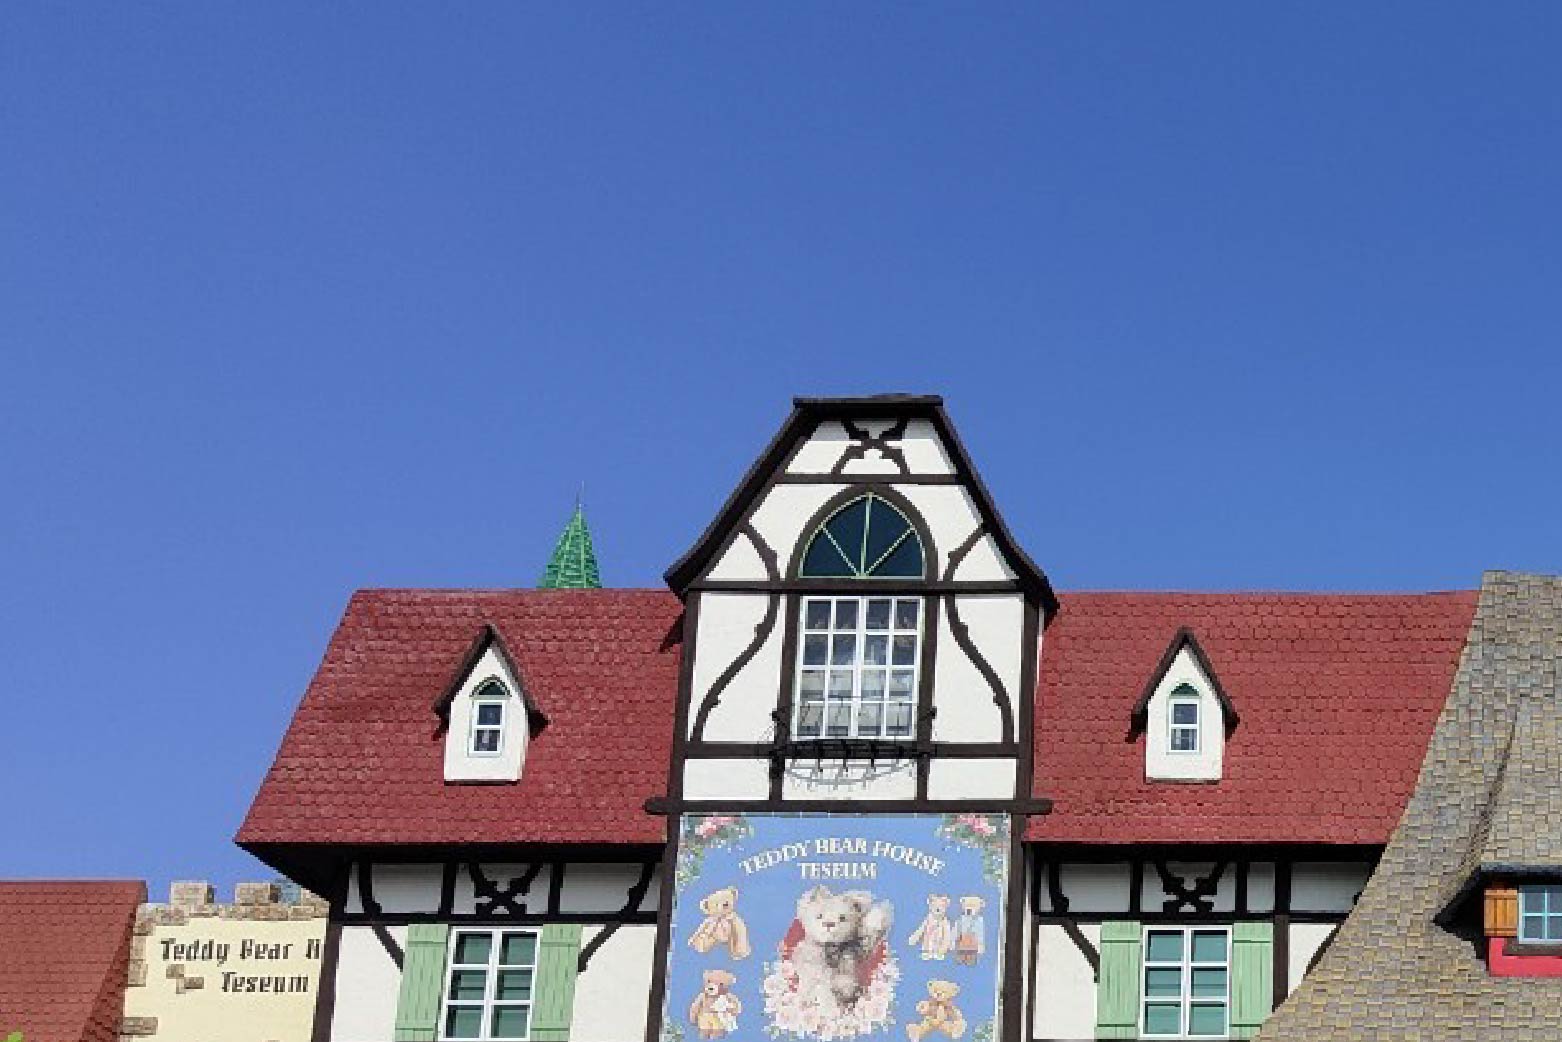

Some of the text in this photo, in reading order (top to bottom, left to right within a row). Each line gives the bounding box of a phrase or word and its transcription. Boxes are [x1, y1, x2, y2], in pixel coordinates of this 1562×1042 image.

[738, 837, 946, 876] TEDDY BEAR HOUSE
[796, 862, 877, 880] TESEUM
[160, 937, 231, 967] Teddy
[239, 937, 294, 960] Bear
[221, 971, 309, 993] Teseum
